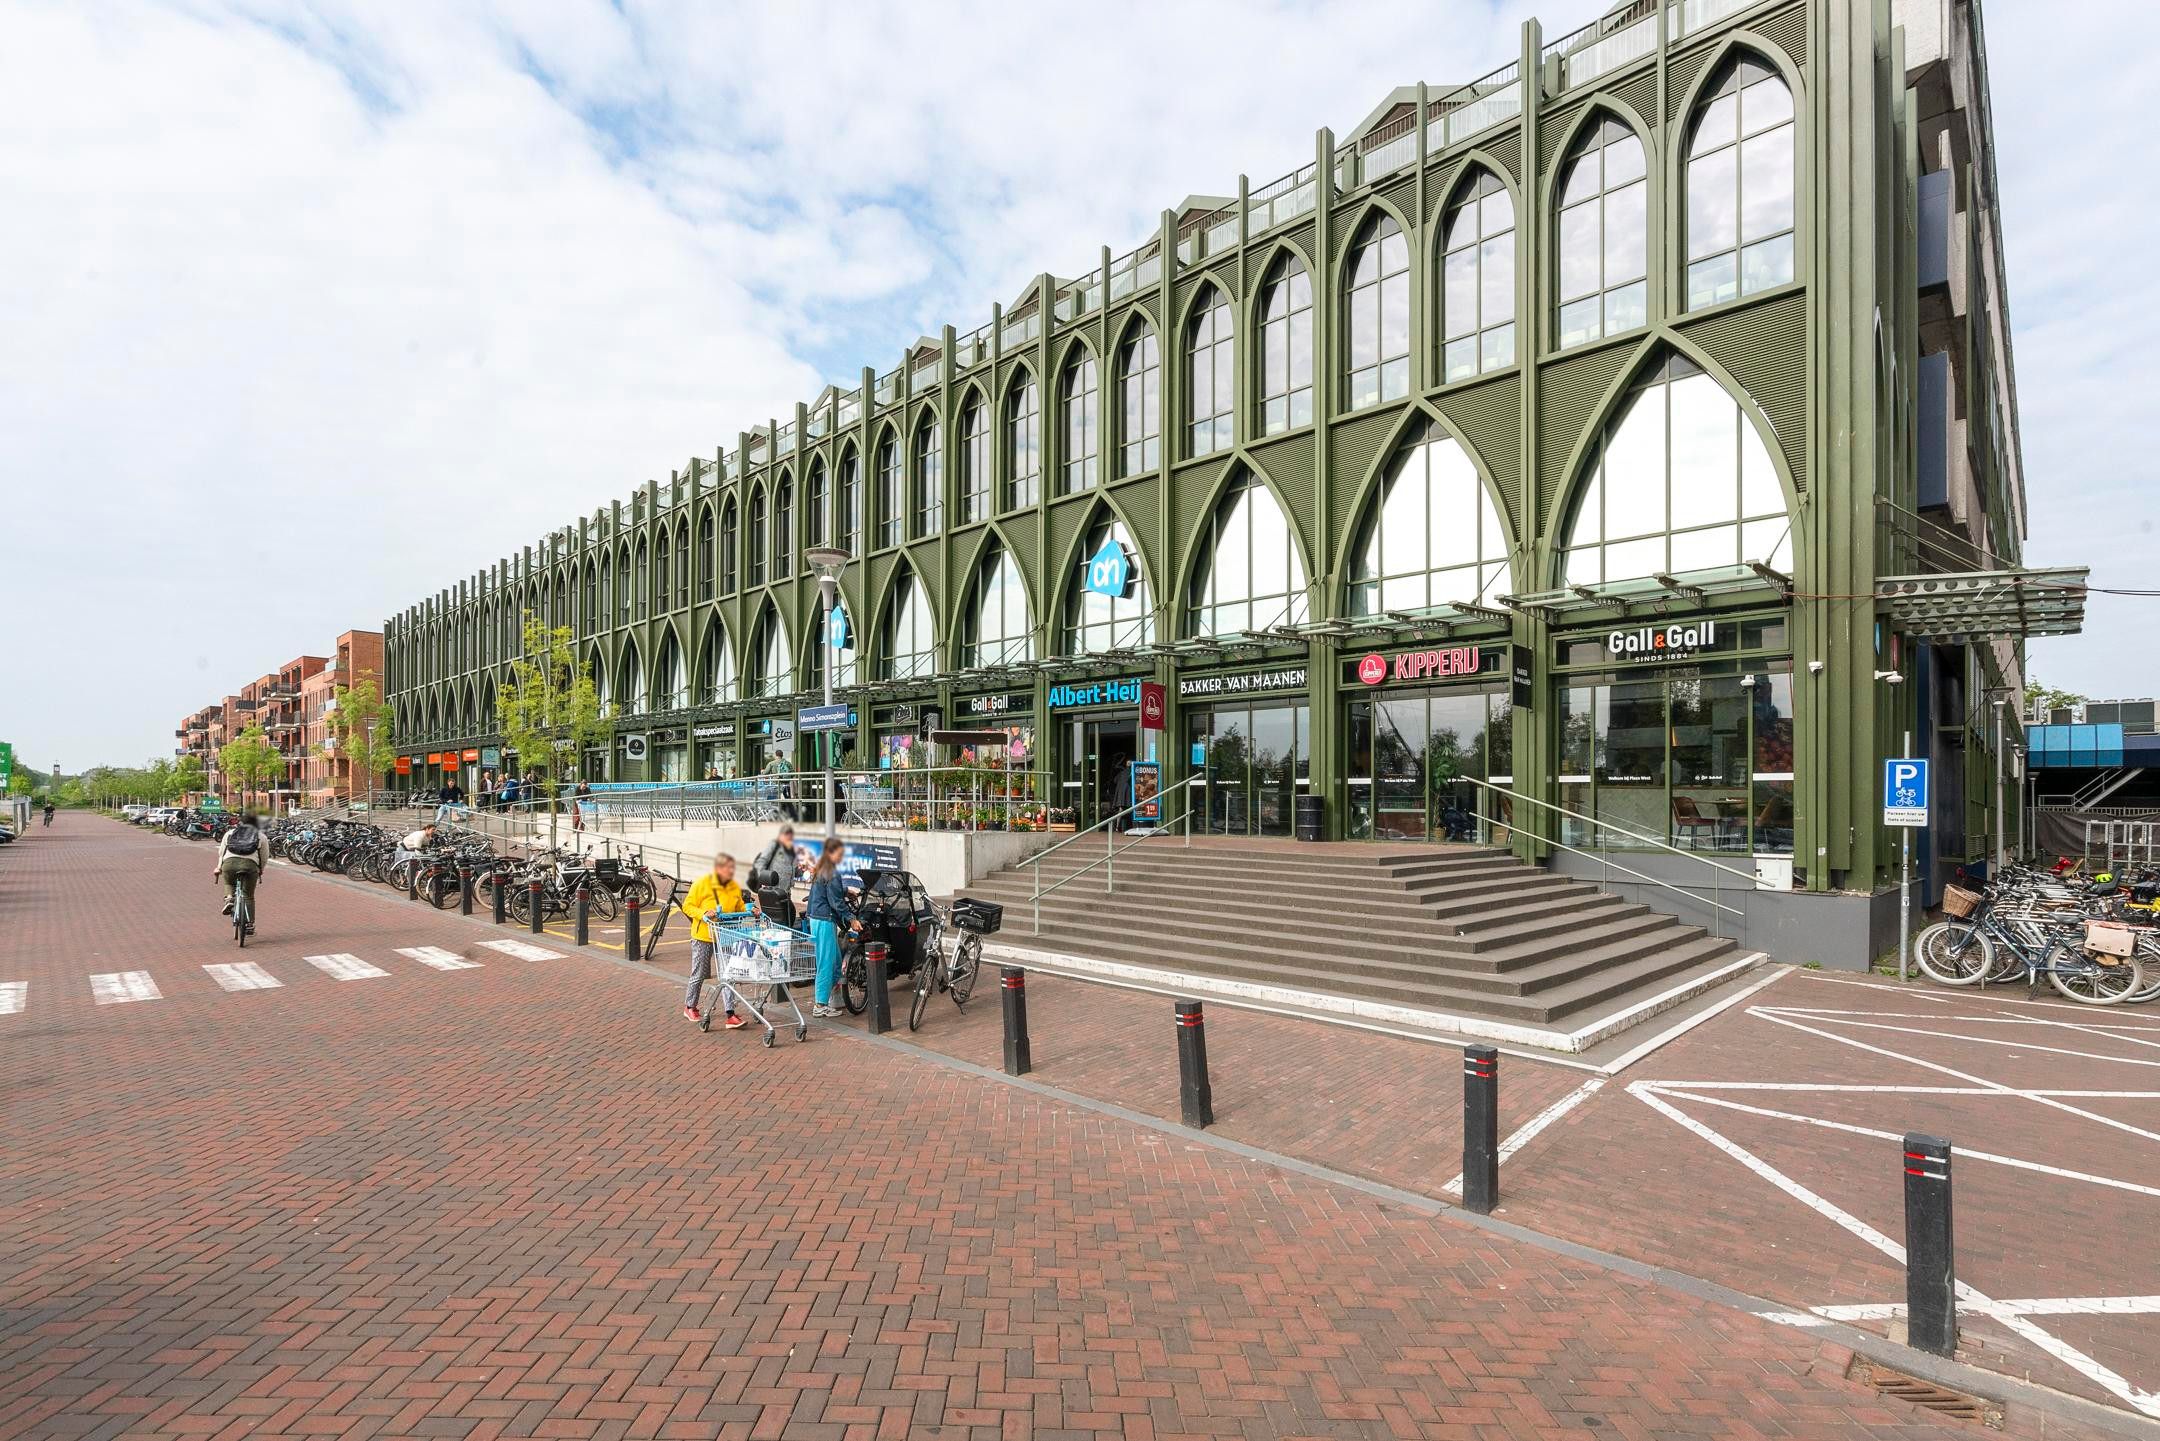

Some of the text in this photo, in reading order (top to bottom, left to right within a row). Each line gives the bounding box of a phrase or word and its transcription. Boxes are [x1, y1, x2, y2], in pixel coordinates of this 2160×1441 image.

[1395, 646, 1479, 680] KIPPERIJ
[1634, 652, 1688, 663] SINDS 1884
[1048, 678, 1141, 707] Albert Heij
[1180, 669, 1305, 694] BAKKER VAN MAANEN
[775, 727, 793, 739] Etos
[1895, 764, 1918, 788] P
